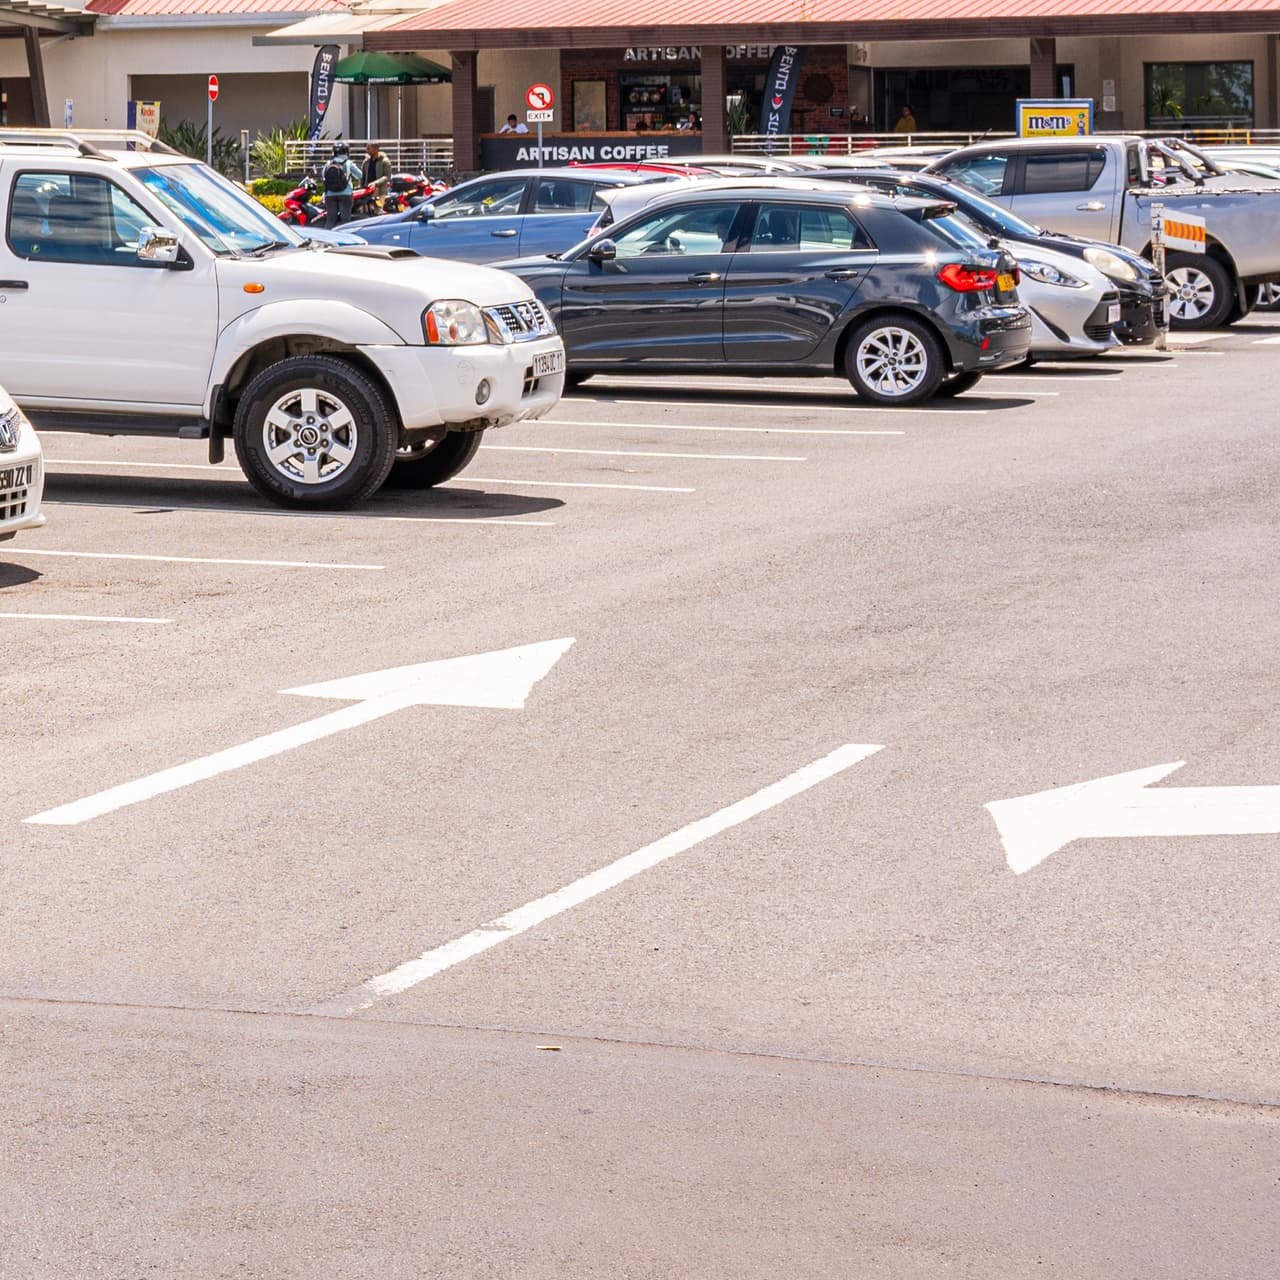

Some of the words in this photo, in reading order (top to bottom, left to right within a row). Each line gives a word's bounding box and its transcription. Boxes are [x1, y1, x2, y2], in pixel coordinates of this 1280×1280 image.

[623, 46, 702, 61] ARTISAN
[317, 52, 333, 97] BENTO
[775, 46, 798, 91] BENTO
[528, 112, 547, 120] EXIT
[516, 146, 595, 161] ARTISAN
[599, 145, 669, 160] COFFEE
[15, 466, 26, 487] ZZ
